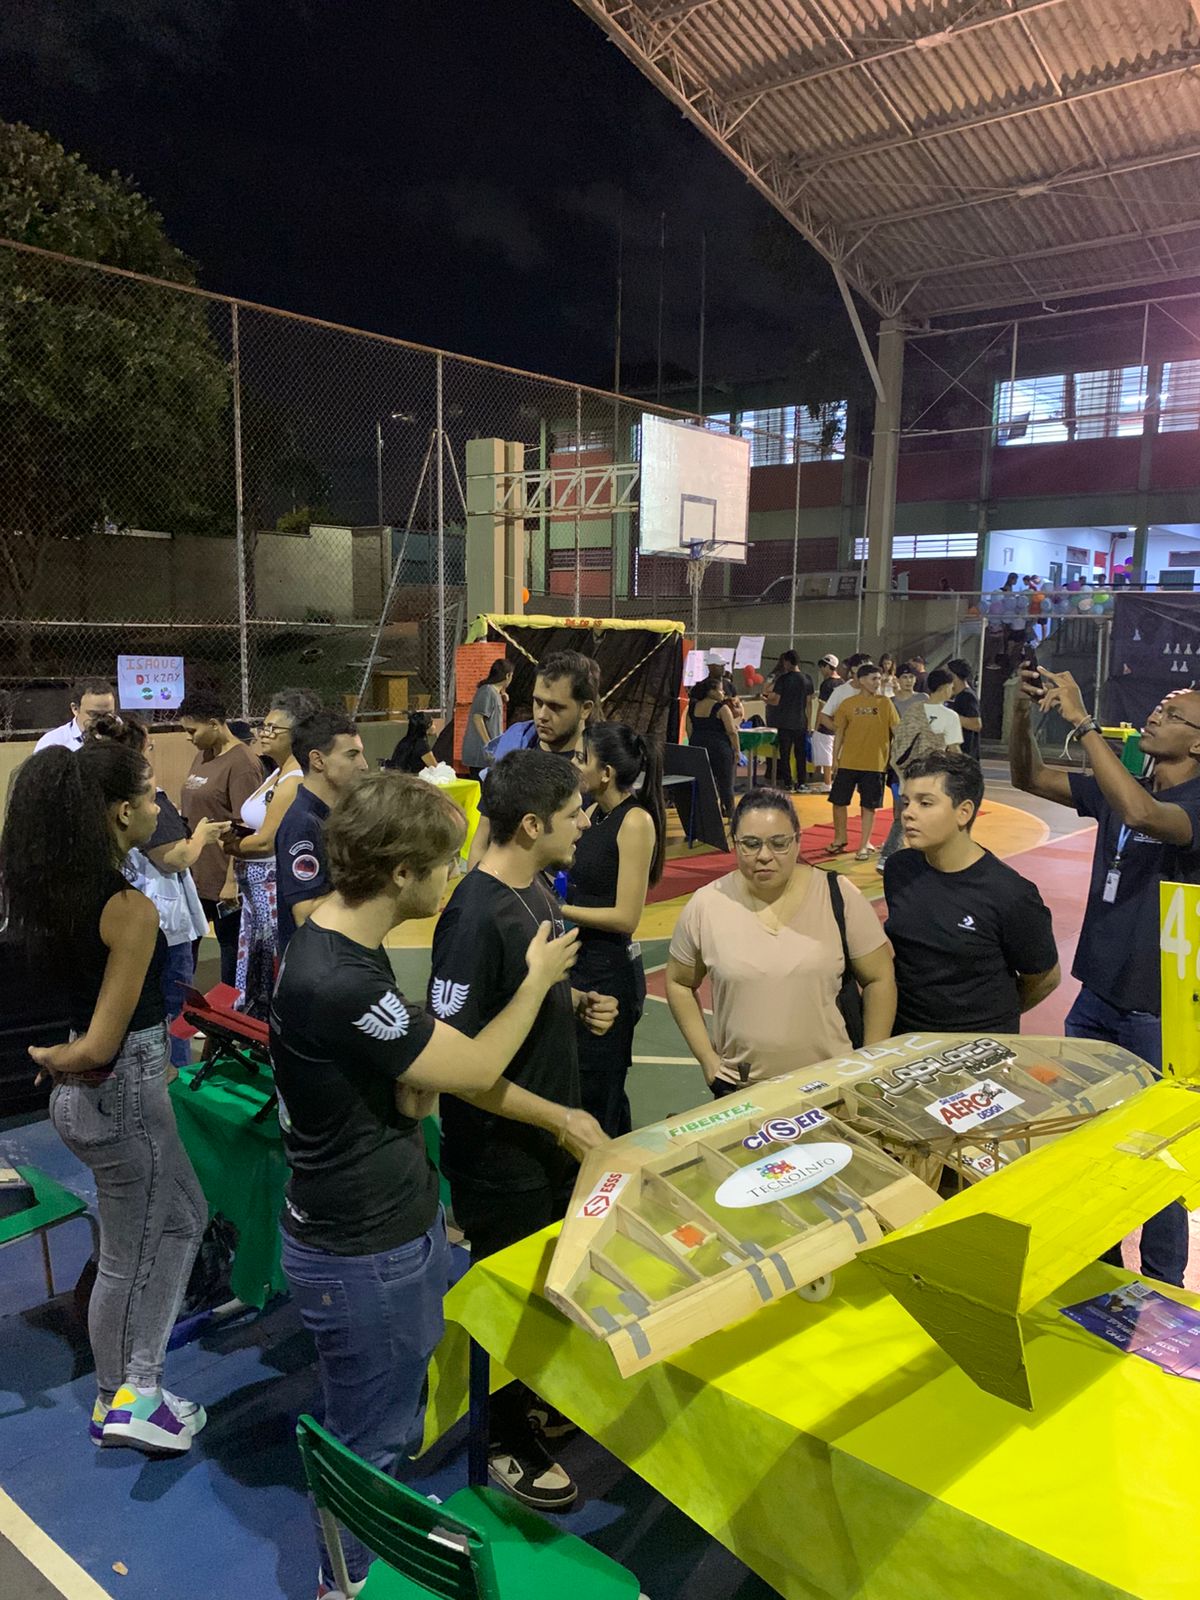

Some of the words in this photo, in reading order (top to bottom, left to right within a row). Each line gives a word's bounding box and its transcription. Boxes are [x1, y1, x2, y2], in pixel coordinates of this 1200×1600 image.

[126, 658, 177, 670] ISAQUE
[136, 674, 150, 685] DJ
[1160, 886, 1200, 980] 4
[668, 1102, 754, 1137] FIBERTEX
[977, 1103, 1004, 1120] DESIGN
[742, 1109, 826, 1150] CISER
[600, 1173, 622, 1193] ESSS
